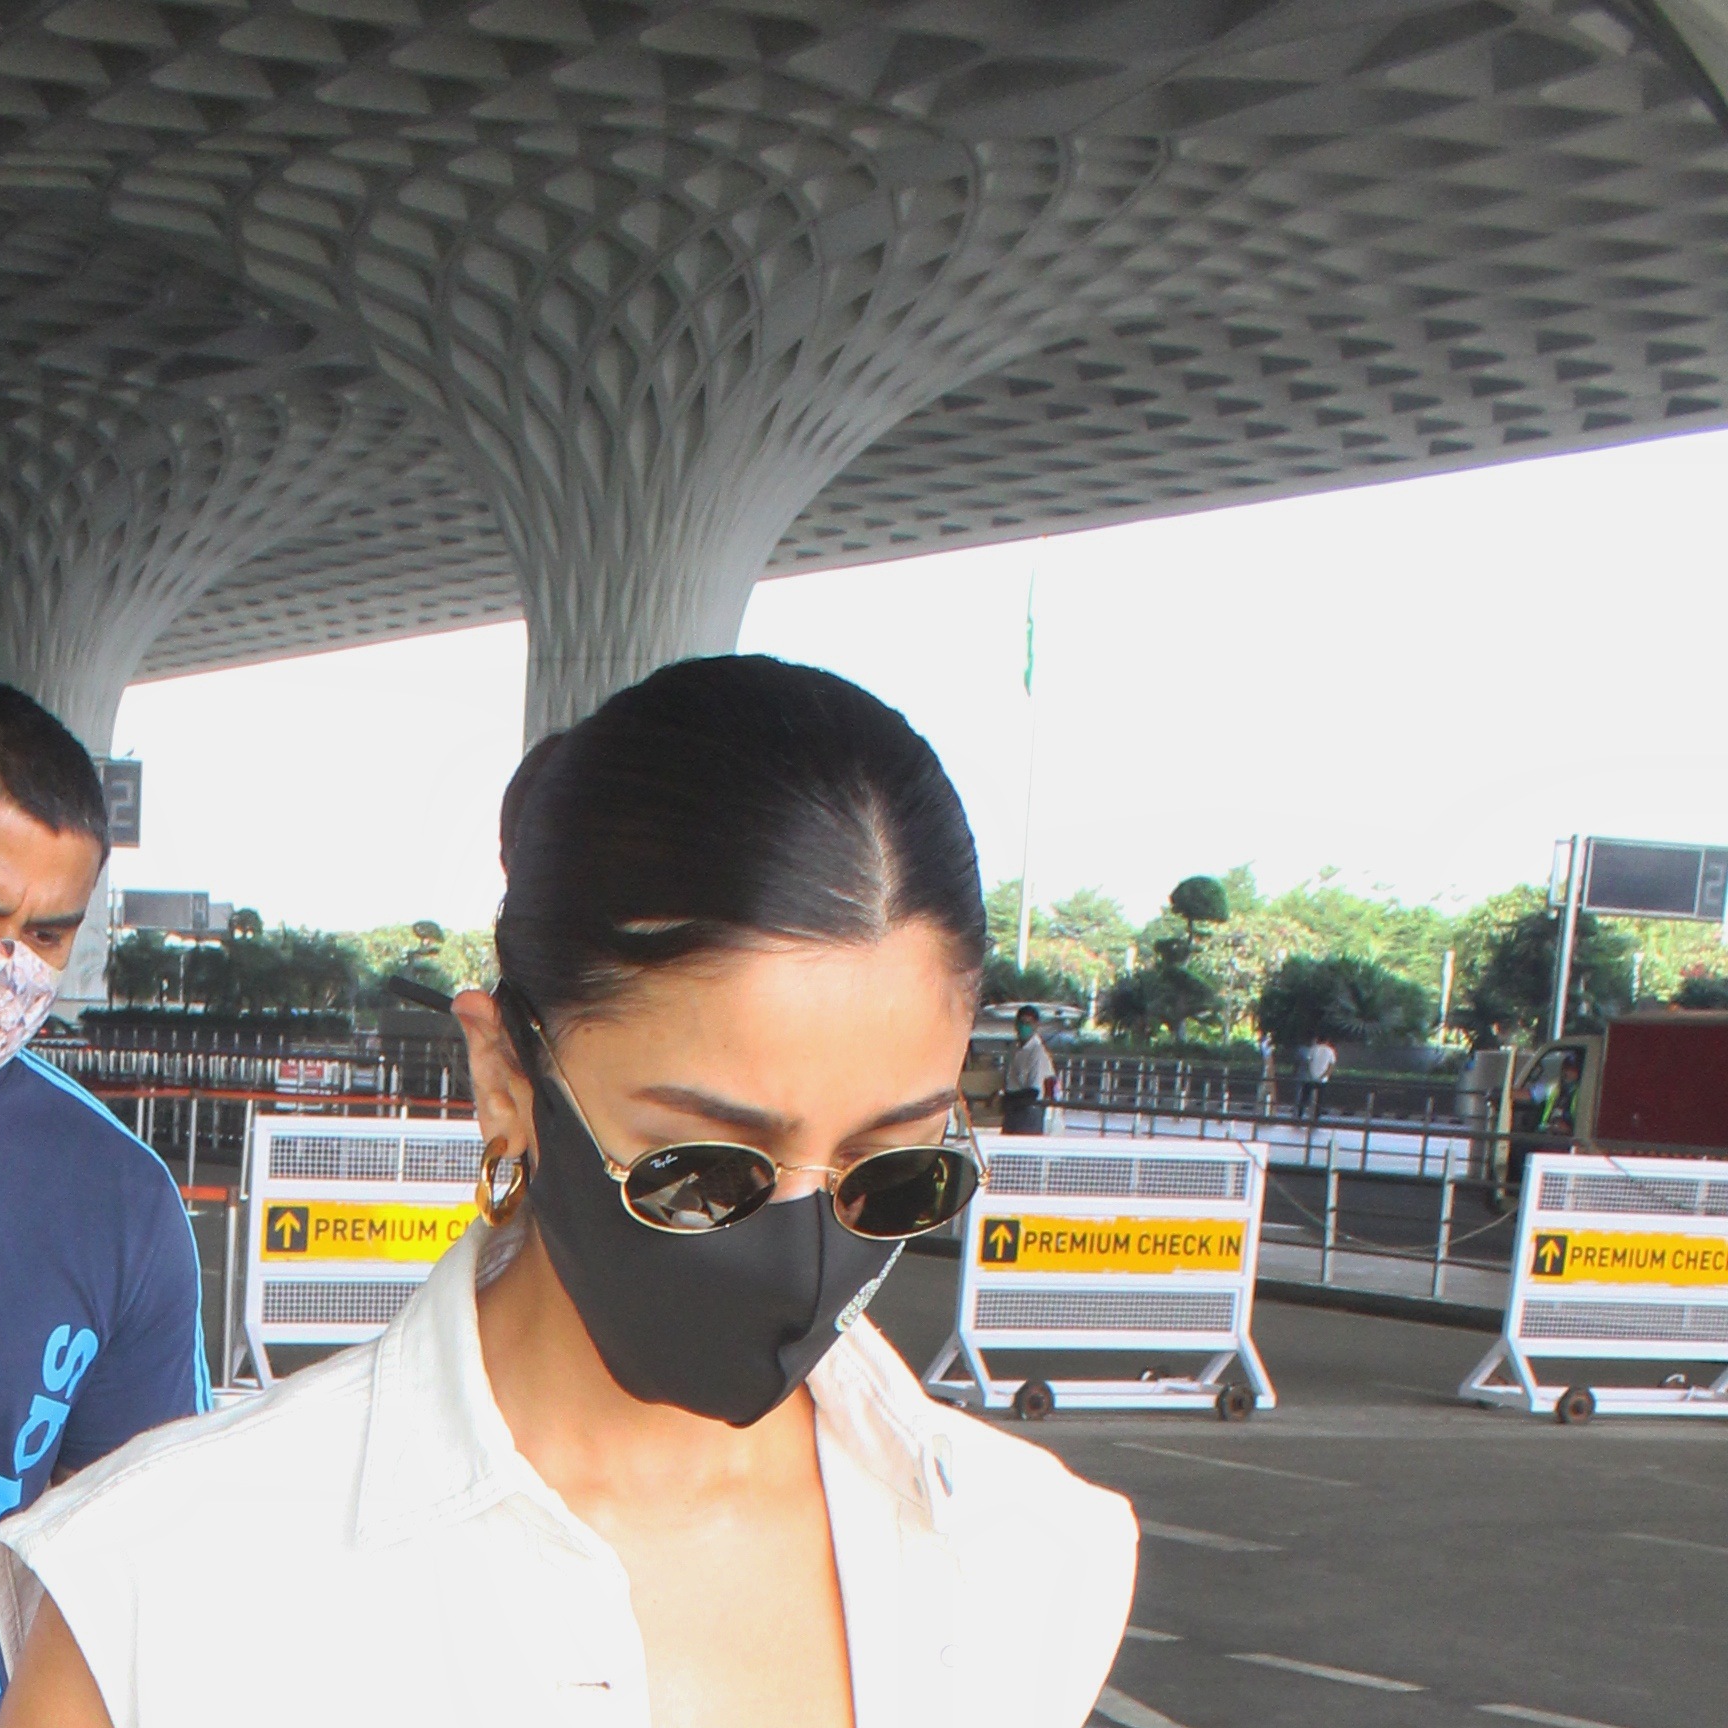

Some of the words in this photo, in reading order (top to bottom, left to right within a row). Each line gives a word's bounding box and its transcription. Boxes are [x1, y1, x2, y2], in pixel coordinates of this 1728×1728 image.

[314, 1218, 438, 1242] PREMIUM
[446, 1219, 471, 1242] C
[1023, 1231, 1131, 1254] PREMIUM
[1137, 1233, 1211, 1256] CHECK
[1219, 1235, 1241, 1256] IN
[1571, 1246, 1666, 1269] PREMIUM
[1672, 1249, 1728, 1271] CHEC
